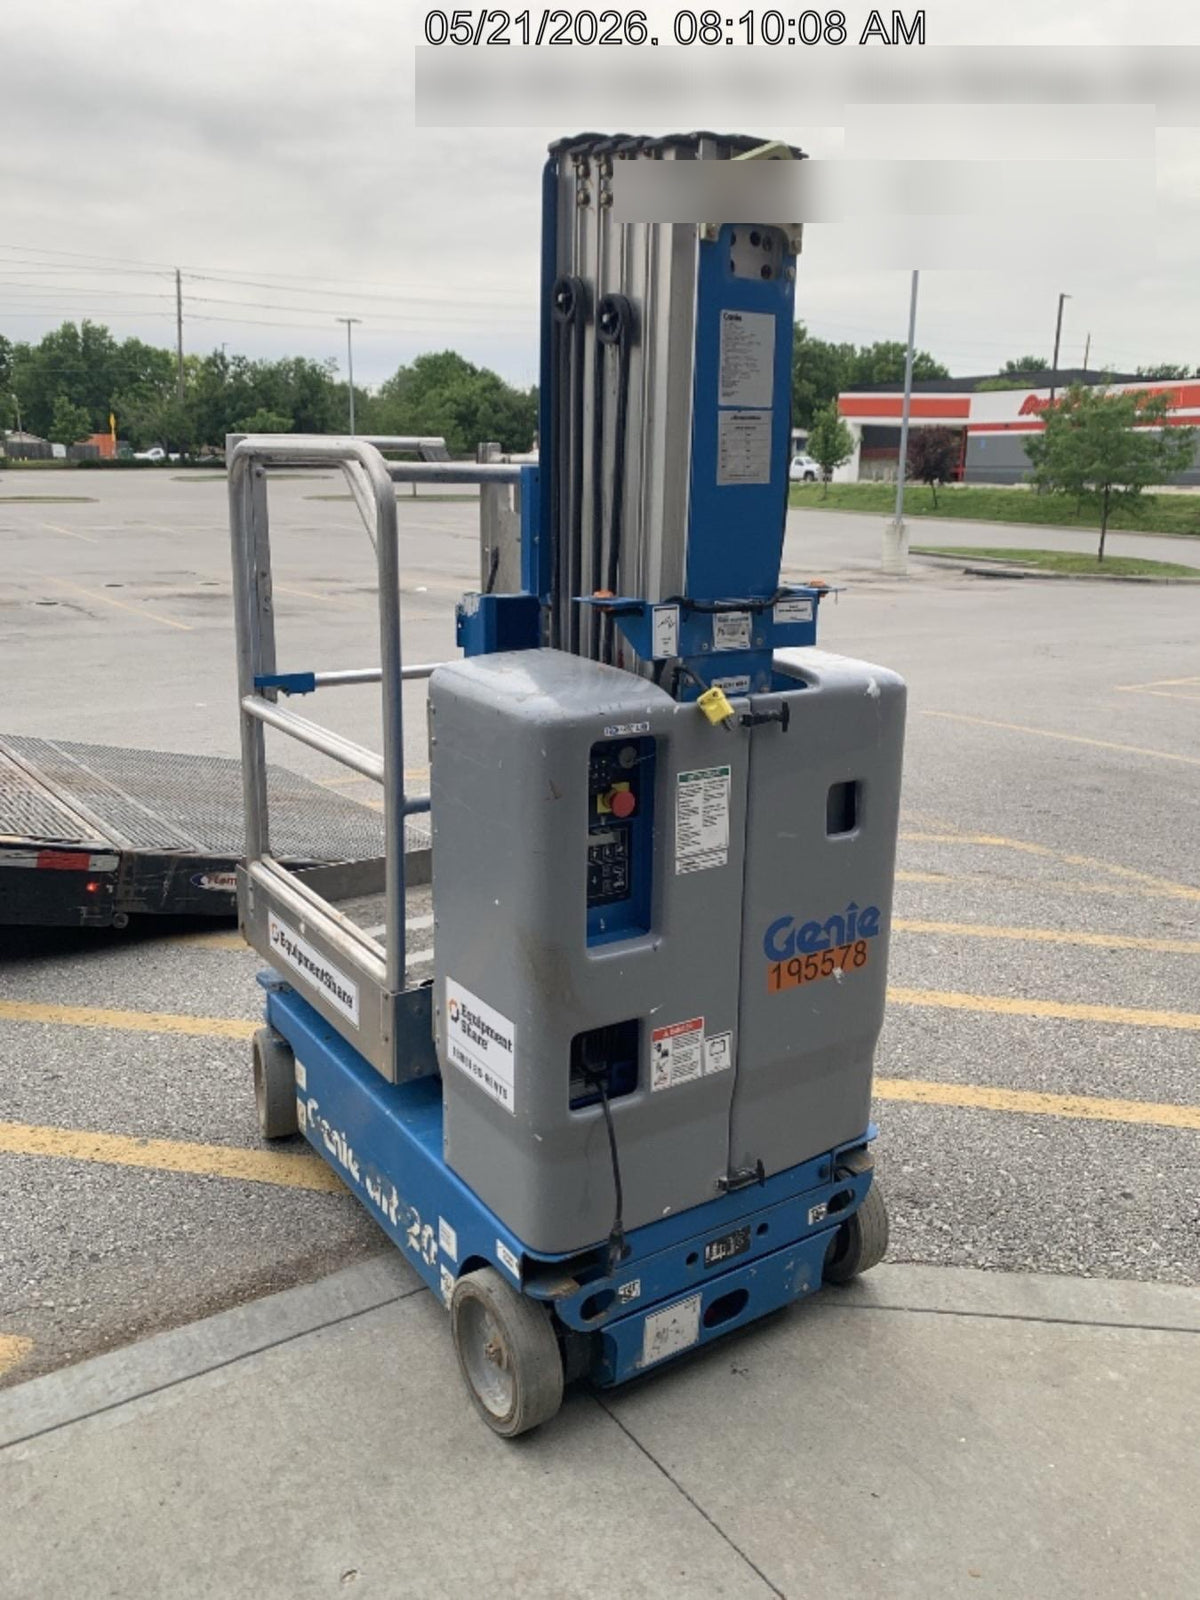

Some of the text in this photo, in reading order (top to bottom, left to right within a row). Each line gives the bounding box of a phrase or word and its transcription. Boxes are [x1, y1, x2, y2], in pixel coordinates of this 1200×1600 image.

[763, 901, 880, 962] Genie
[771, 940, 867, 989] 195578
[461, 1003, 513, 1053] Equipment
